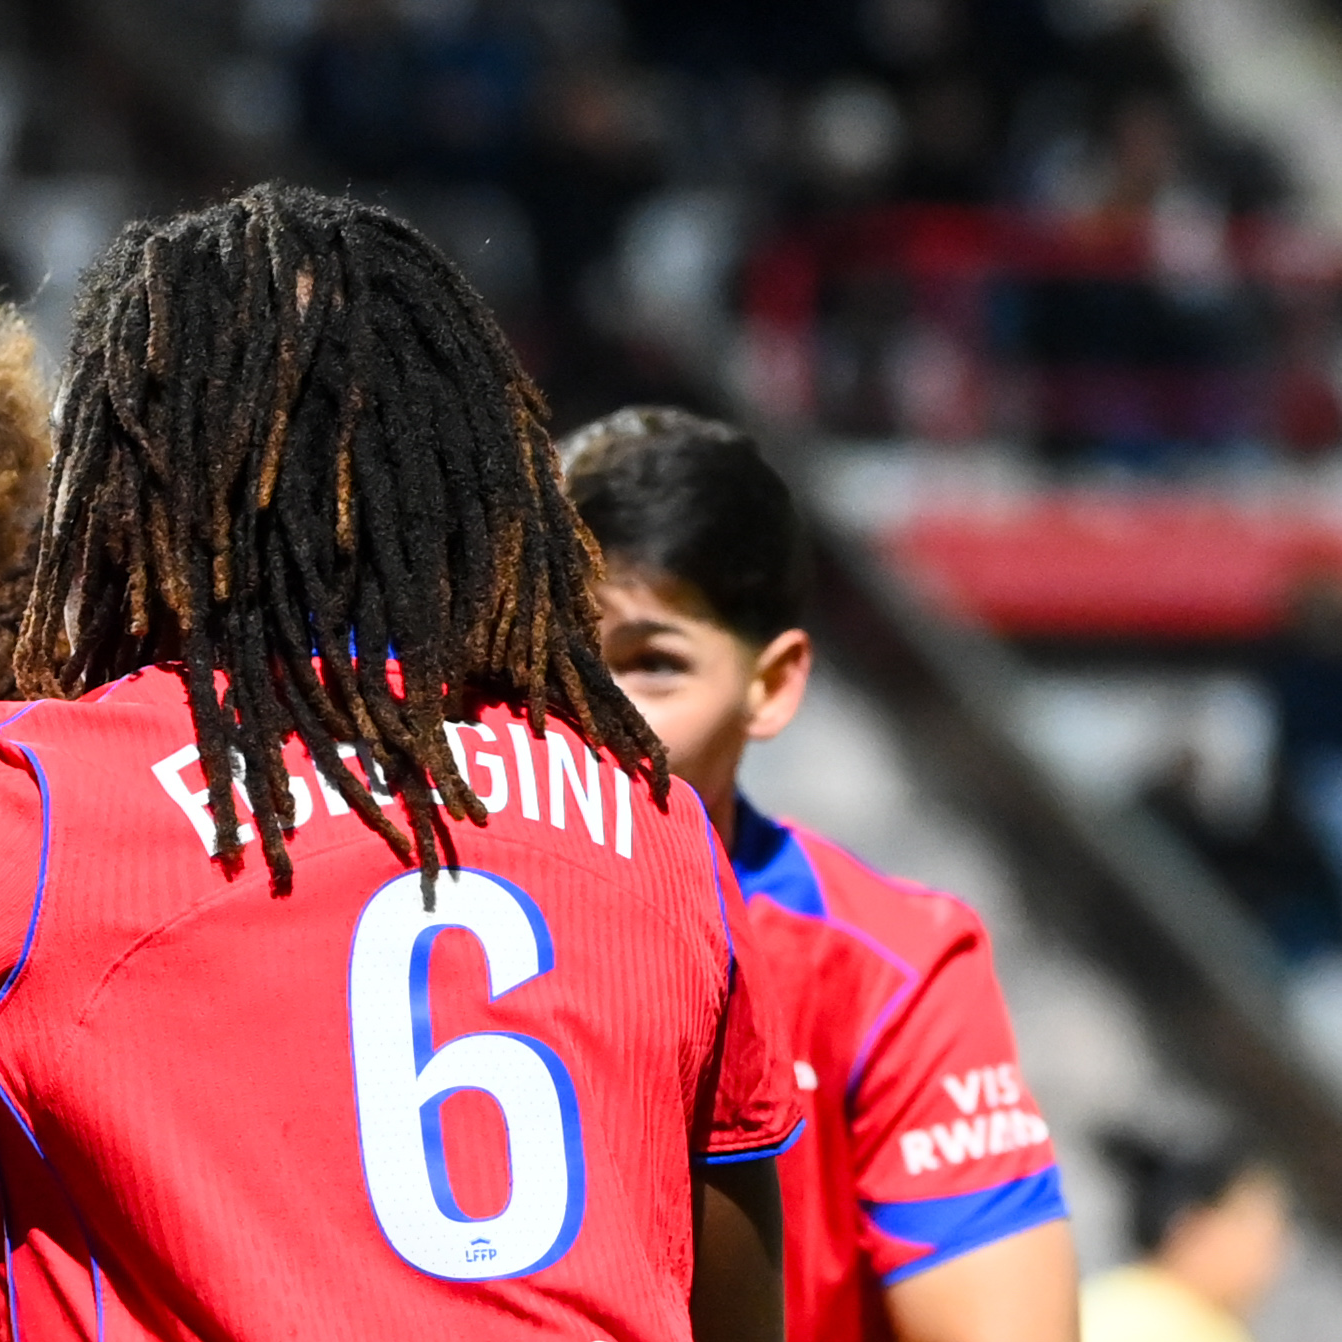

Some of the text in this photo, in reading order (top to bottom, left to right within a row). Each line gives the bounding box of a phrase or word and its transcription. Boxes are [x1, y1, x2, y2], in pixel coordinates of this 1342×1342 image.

[347, 866, 588, 1282] 6
[942, 1063, 1021, 1114] VIS
[465, 1248, 497, 1263] LFFP
